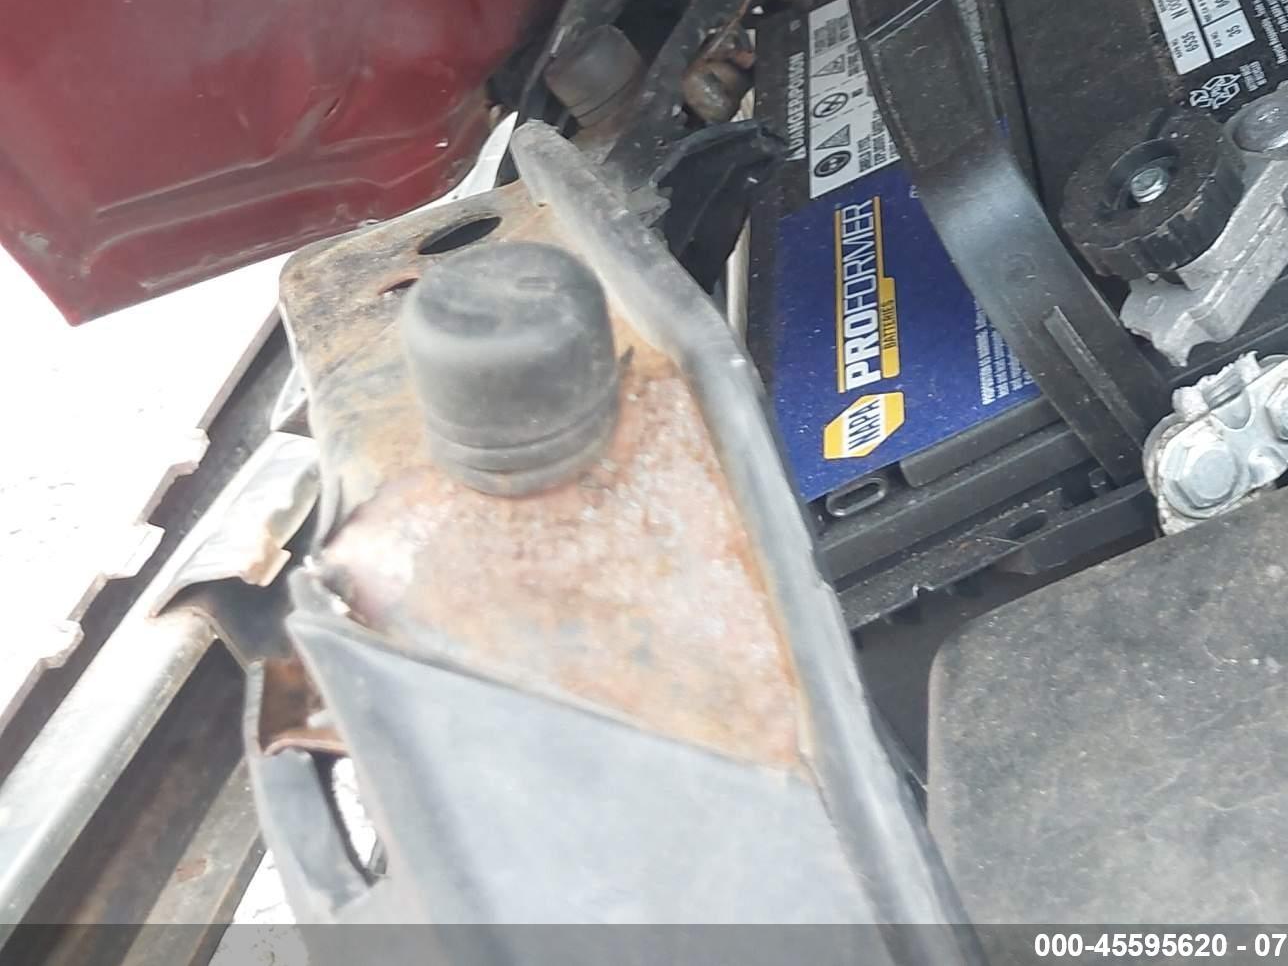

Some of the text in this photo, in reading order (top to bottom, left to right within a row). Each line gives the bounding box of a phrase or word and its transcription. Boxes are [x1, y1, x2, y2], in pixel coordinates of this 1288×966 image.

[1178, 29, 1201, 53] 6535
[1225, 23, 1243, 38] 35
[844, 199, 881, 391] PROFORMER
[881, 299, 896, 351] BATTERIES
[848, 398, 879, 455] NAPA
